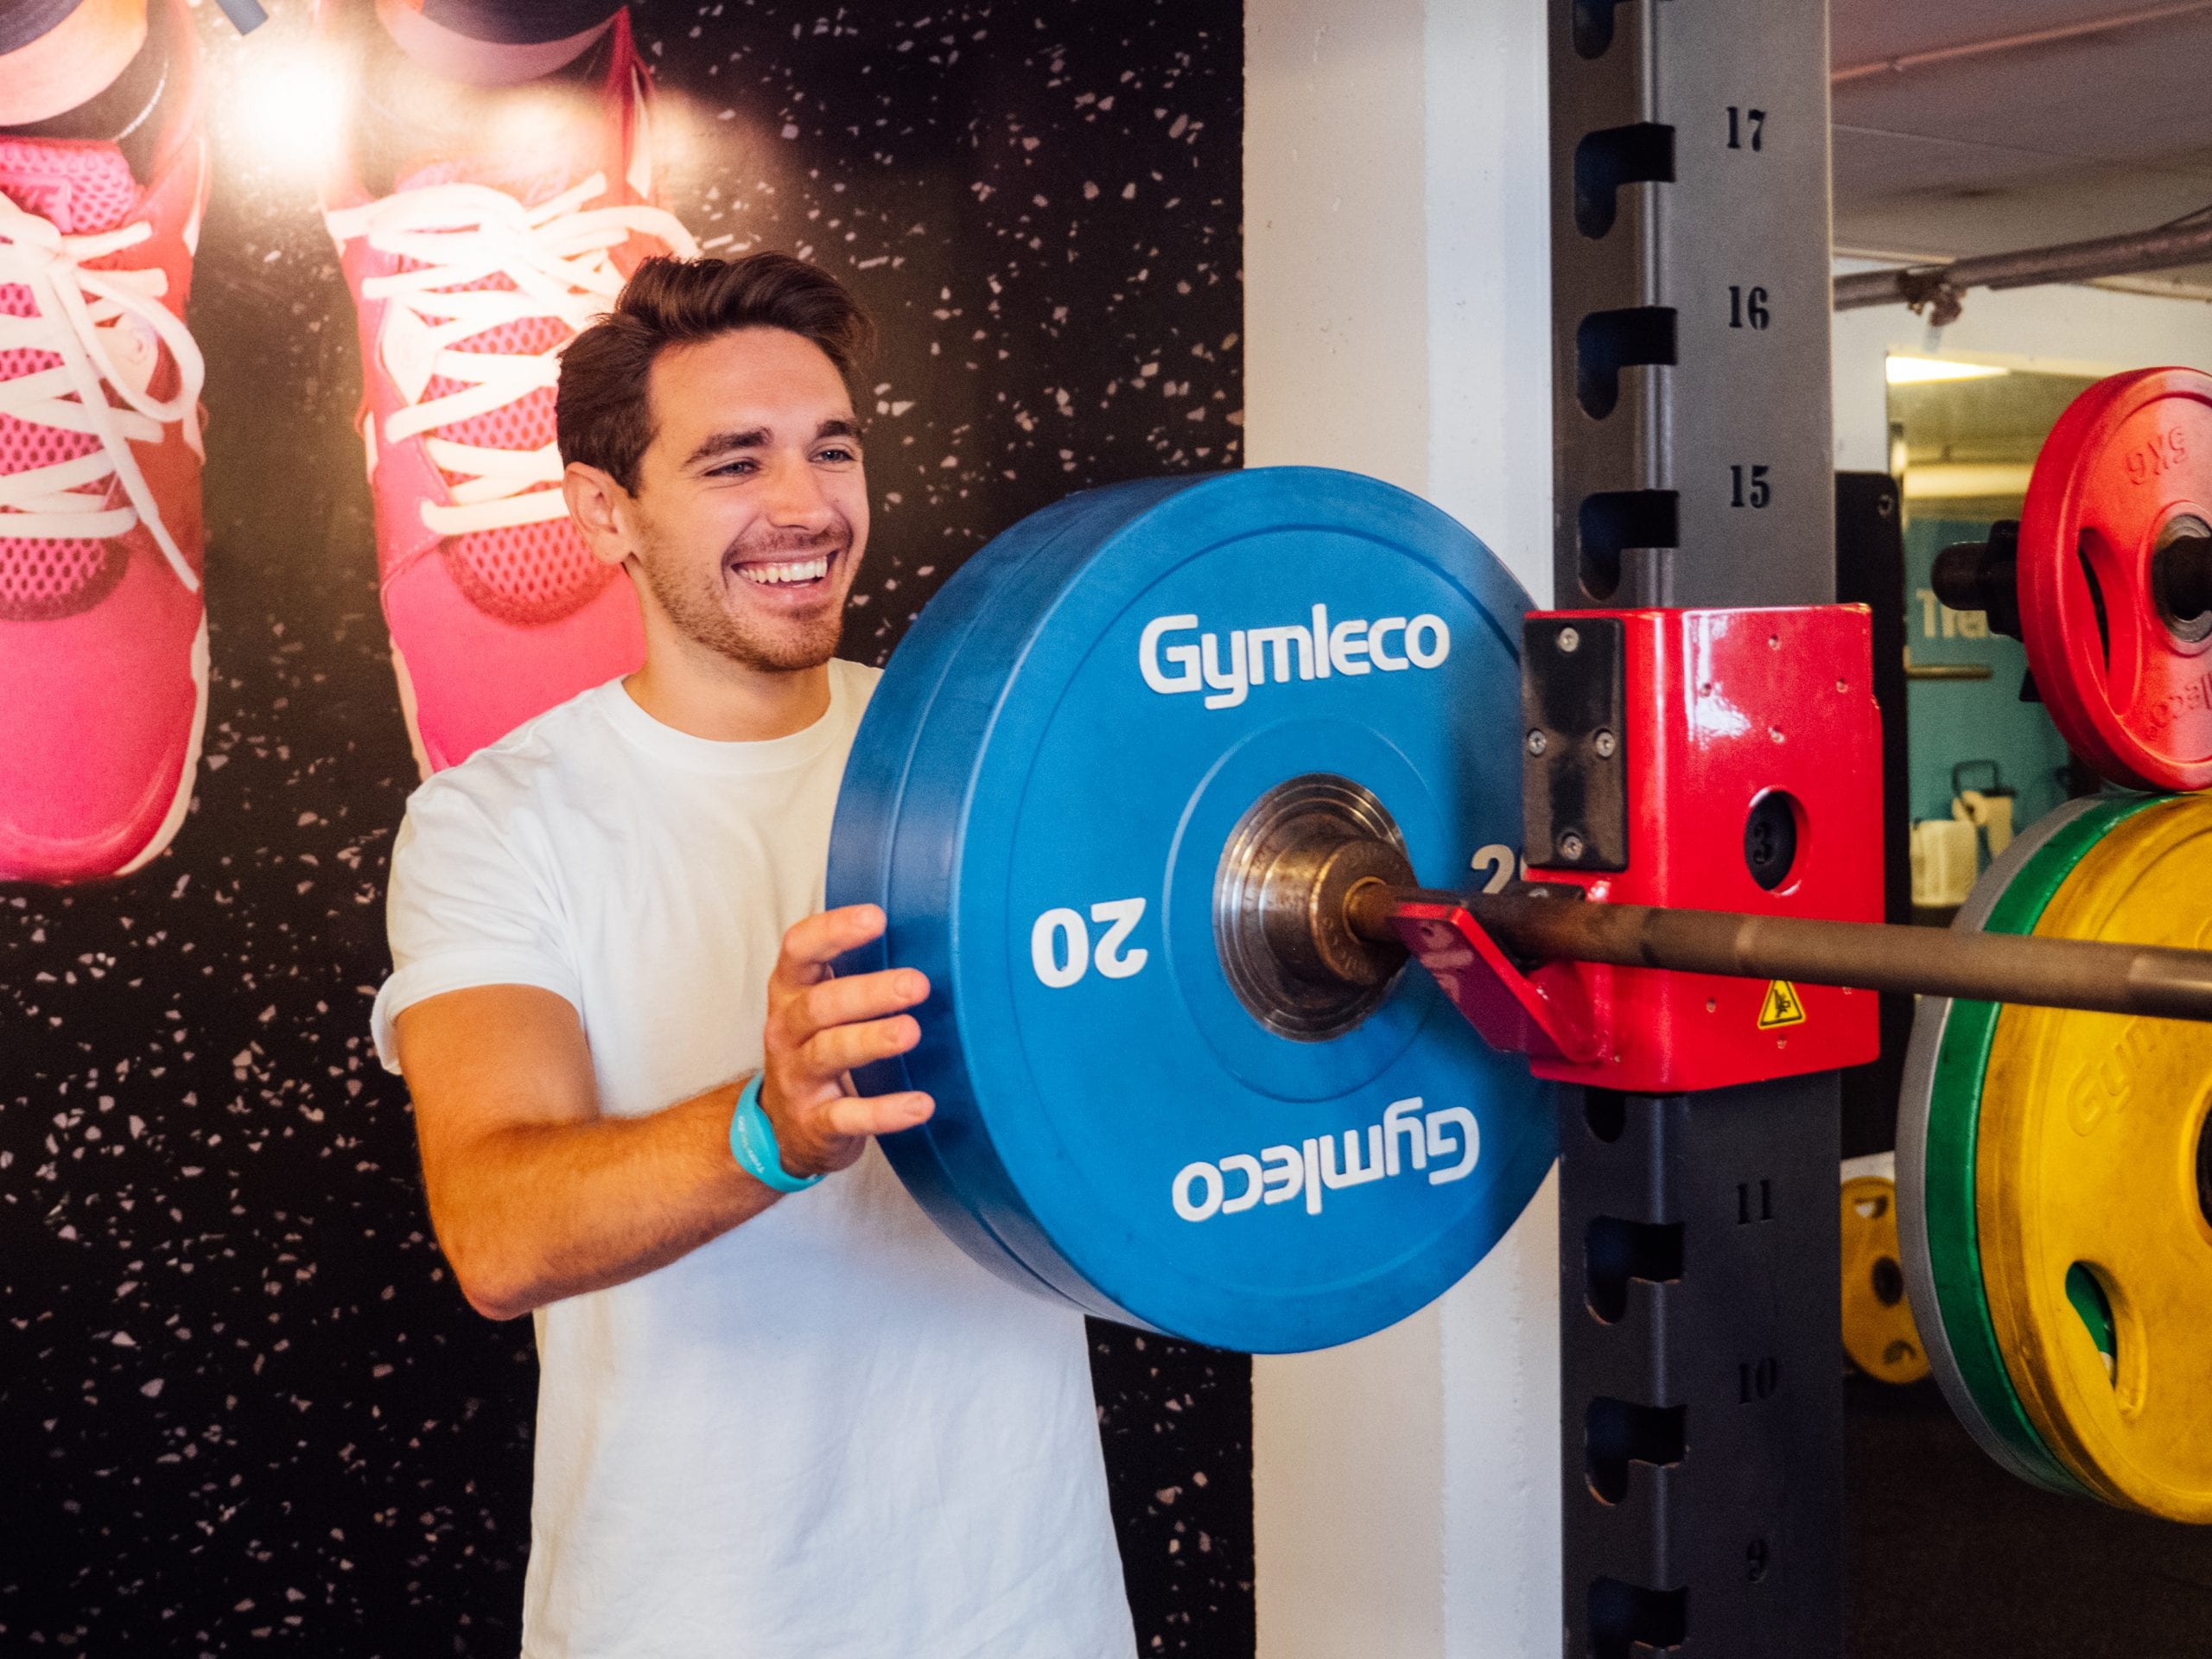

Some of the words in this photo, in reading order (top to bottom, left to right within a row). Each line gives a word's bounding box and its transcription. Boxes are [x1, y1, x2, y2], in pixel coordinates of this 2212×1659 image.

[1726, 106, 1766, 151] 17
[1728, 286, 1770, 330] 16
[1730, 465, 1770, 508] 15
[1139, 603, 1450, 710] Gymleco
[1753, 822, 1774, 865] 3
[1471, 843, 1528, 894] 2
[1031, 897, 1148, 988] 20
[1172, 1096, 1480, 1222] Gymleco
[1736, 1179, 1773, 1225] 11
[1738, 1357, 1777, 1405] 10
[1746, 1538, 1768, 1583] 9
